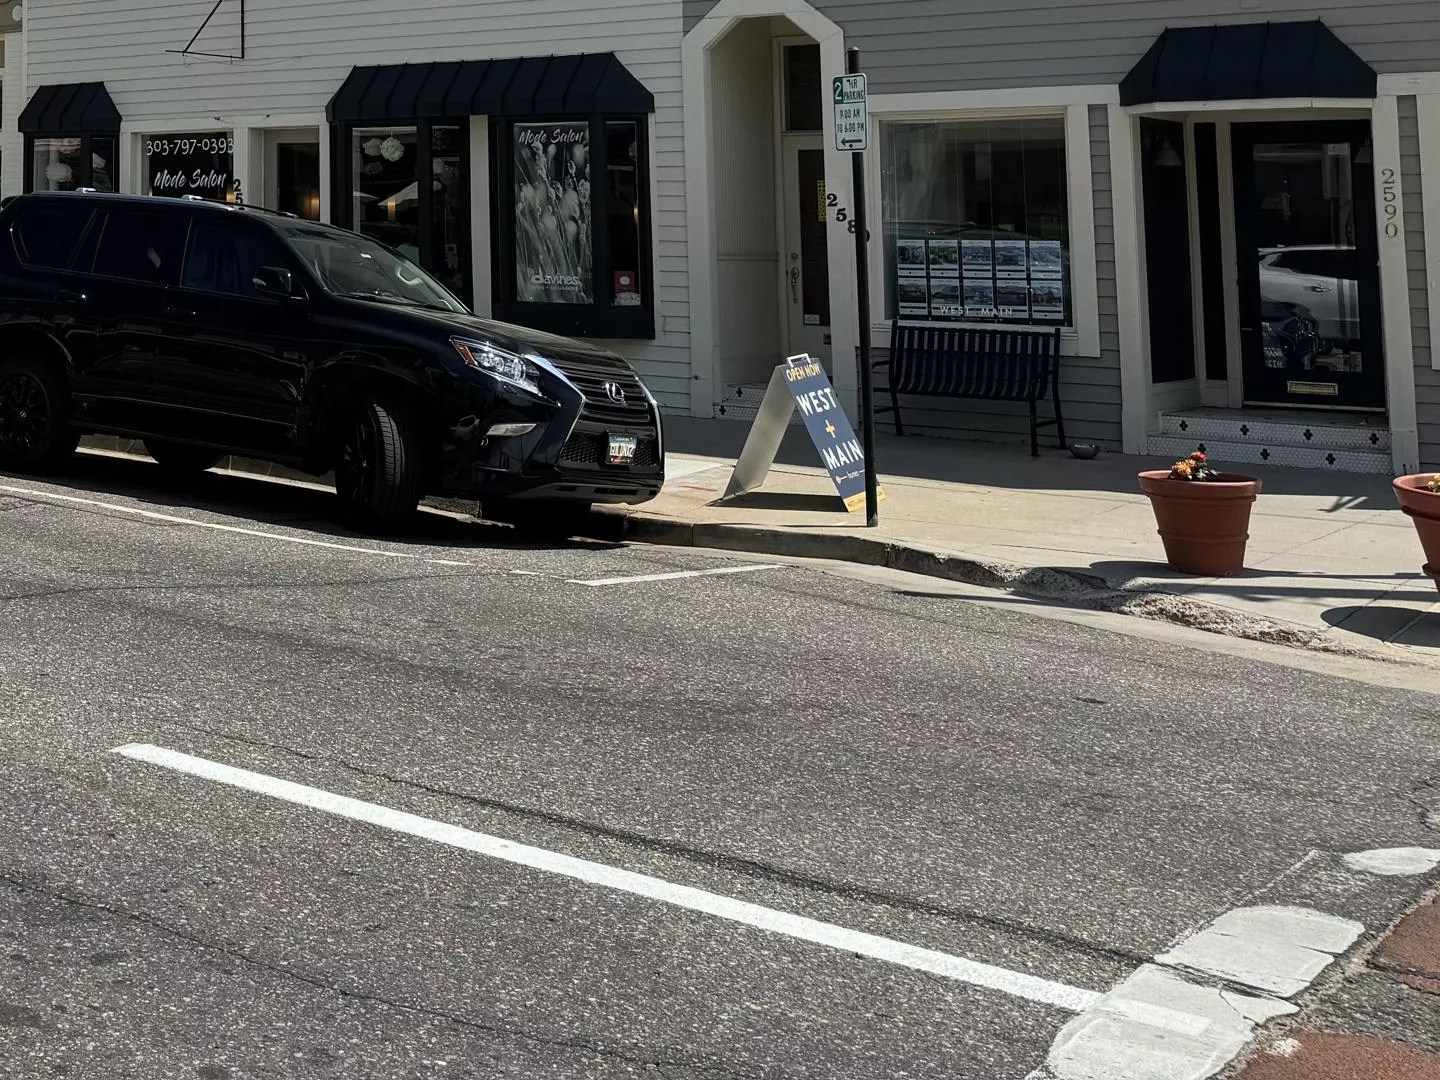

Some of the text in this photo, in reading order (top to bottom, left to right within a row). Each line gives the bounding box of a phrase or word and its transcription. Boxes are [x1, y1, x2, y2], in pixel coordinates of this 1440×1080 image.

[834, 81, 842, 100] 2
[848, 79, 858, 89] HR
[844, 90, 864, 100] PARKING
[853, 108, 860, 118] AM
[857, 122, 864, 132] PM
[519, 128, 584, 145] Mode Salon
[146, 138, 235, 156] 303-797-0393
[154, 168, 227, 190] Mode Salon
[1381, 168, 1398, 239] 2590
[531, 270, 578, 285] davines
[940, 305, 1013, 316] WEST MAIN
[786, 363, 821, 382] OPEN NOW
[796, 387, 837, 417] WEST
[822, 439, 865, 470] MAIN
